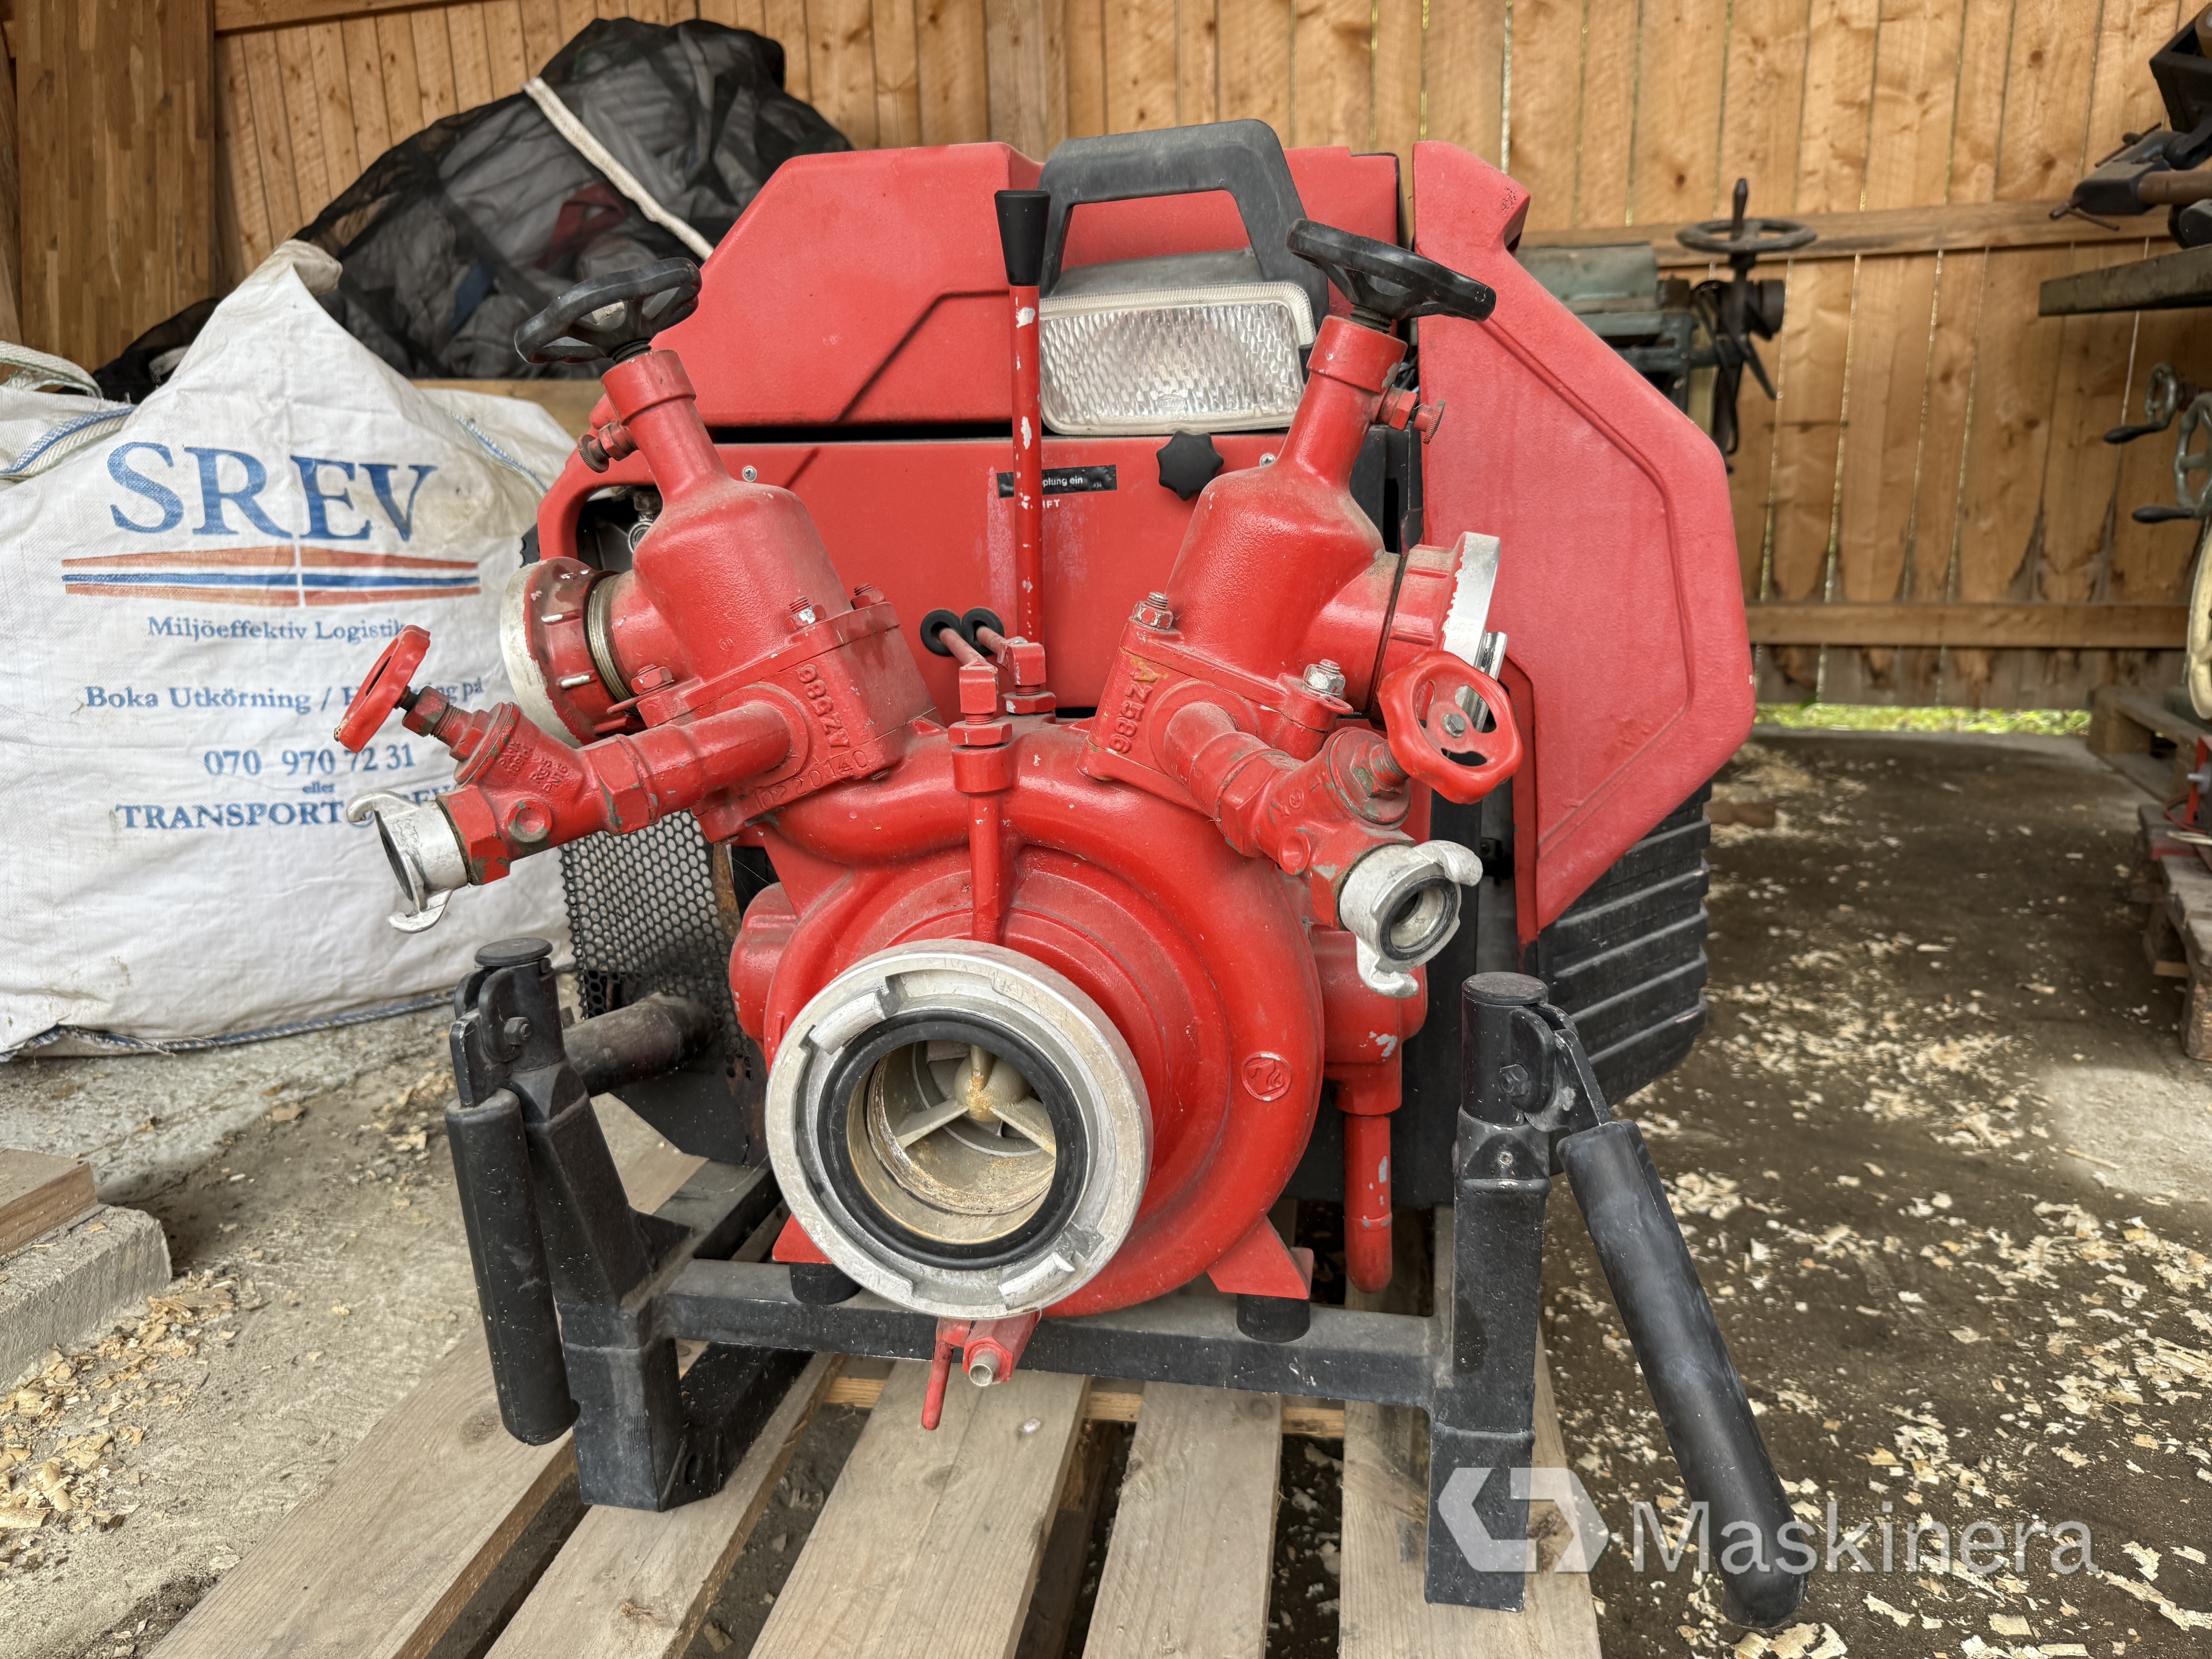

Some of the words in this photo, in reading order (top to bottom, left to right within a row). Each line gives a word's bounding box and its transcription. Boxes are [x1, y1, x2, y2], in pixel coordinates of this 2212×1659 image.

[107, 441, 438, 541] SREV
[1069, 476, 1083, 484] ein
[148, 617, 307, 642] Miljöeffektiv
[316, 620, 405, 645] Logistik
[86, 685, 158, 709] Boka
[169, 687, 312, 715] Utkörning
[204, 749, 263, 777] 070
[281, 749, 336, 777] 970
[344, 746, 379, 772] 72
[386, 744, 416, 771] 31
[302, 781, 335, 795] eller
